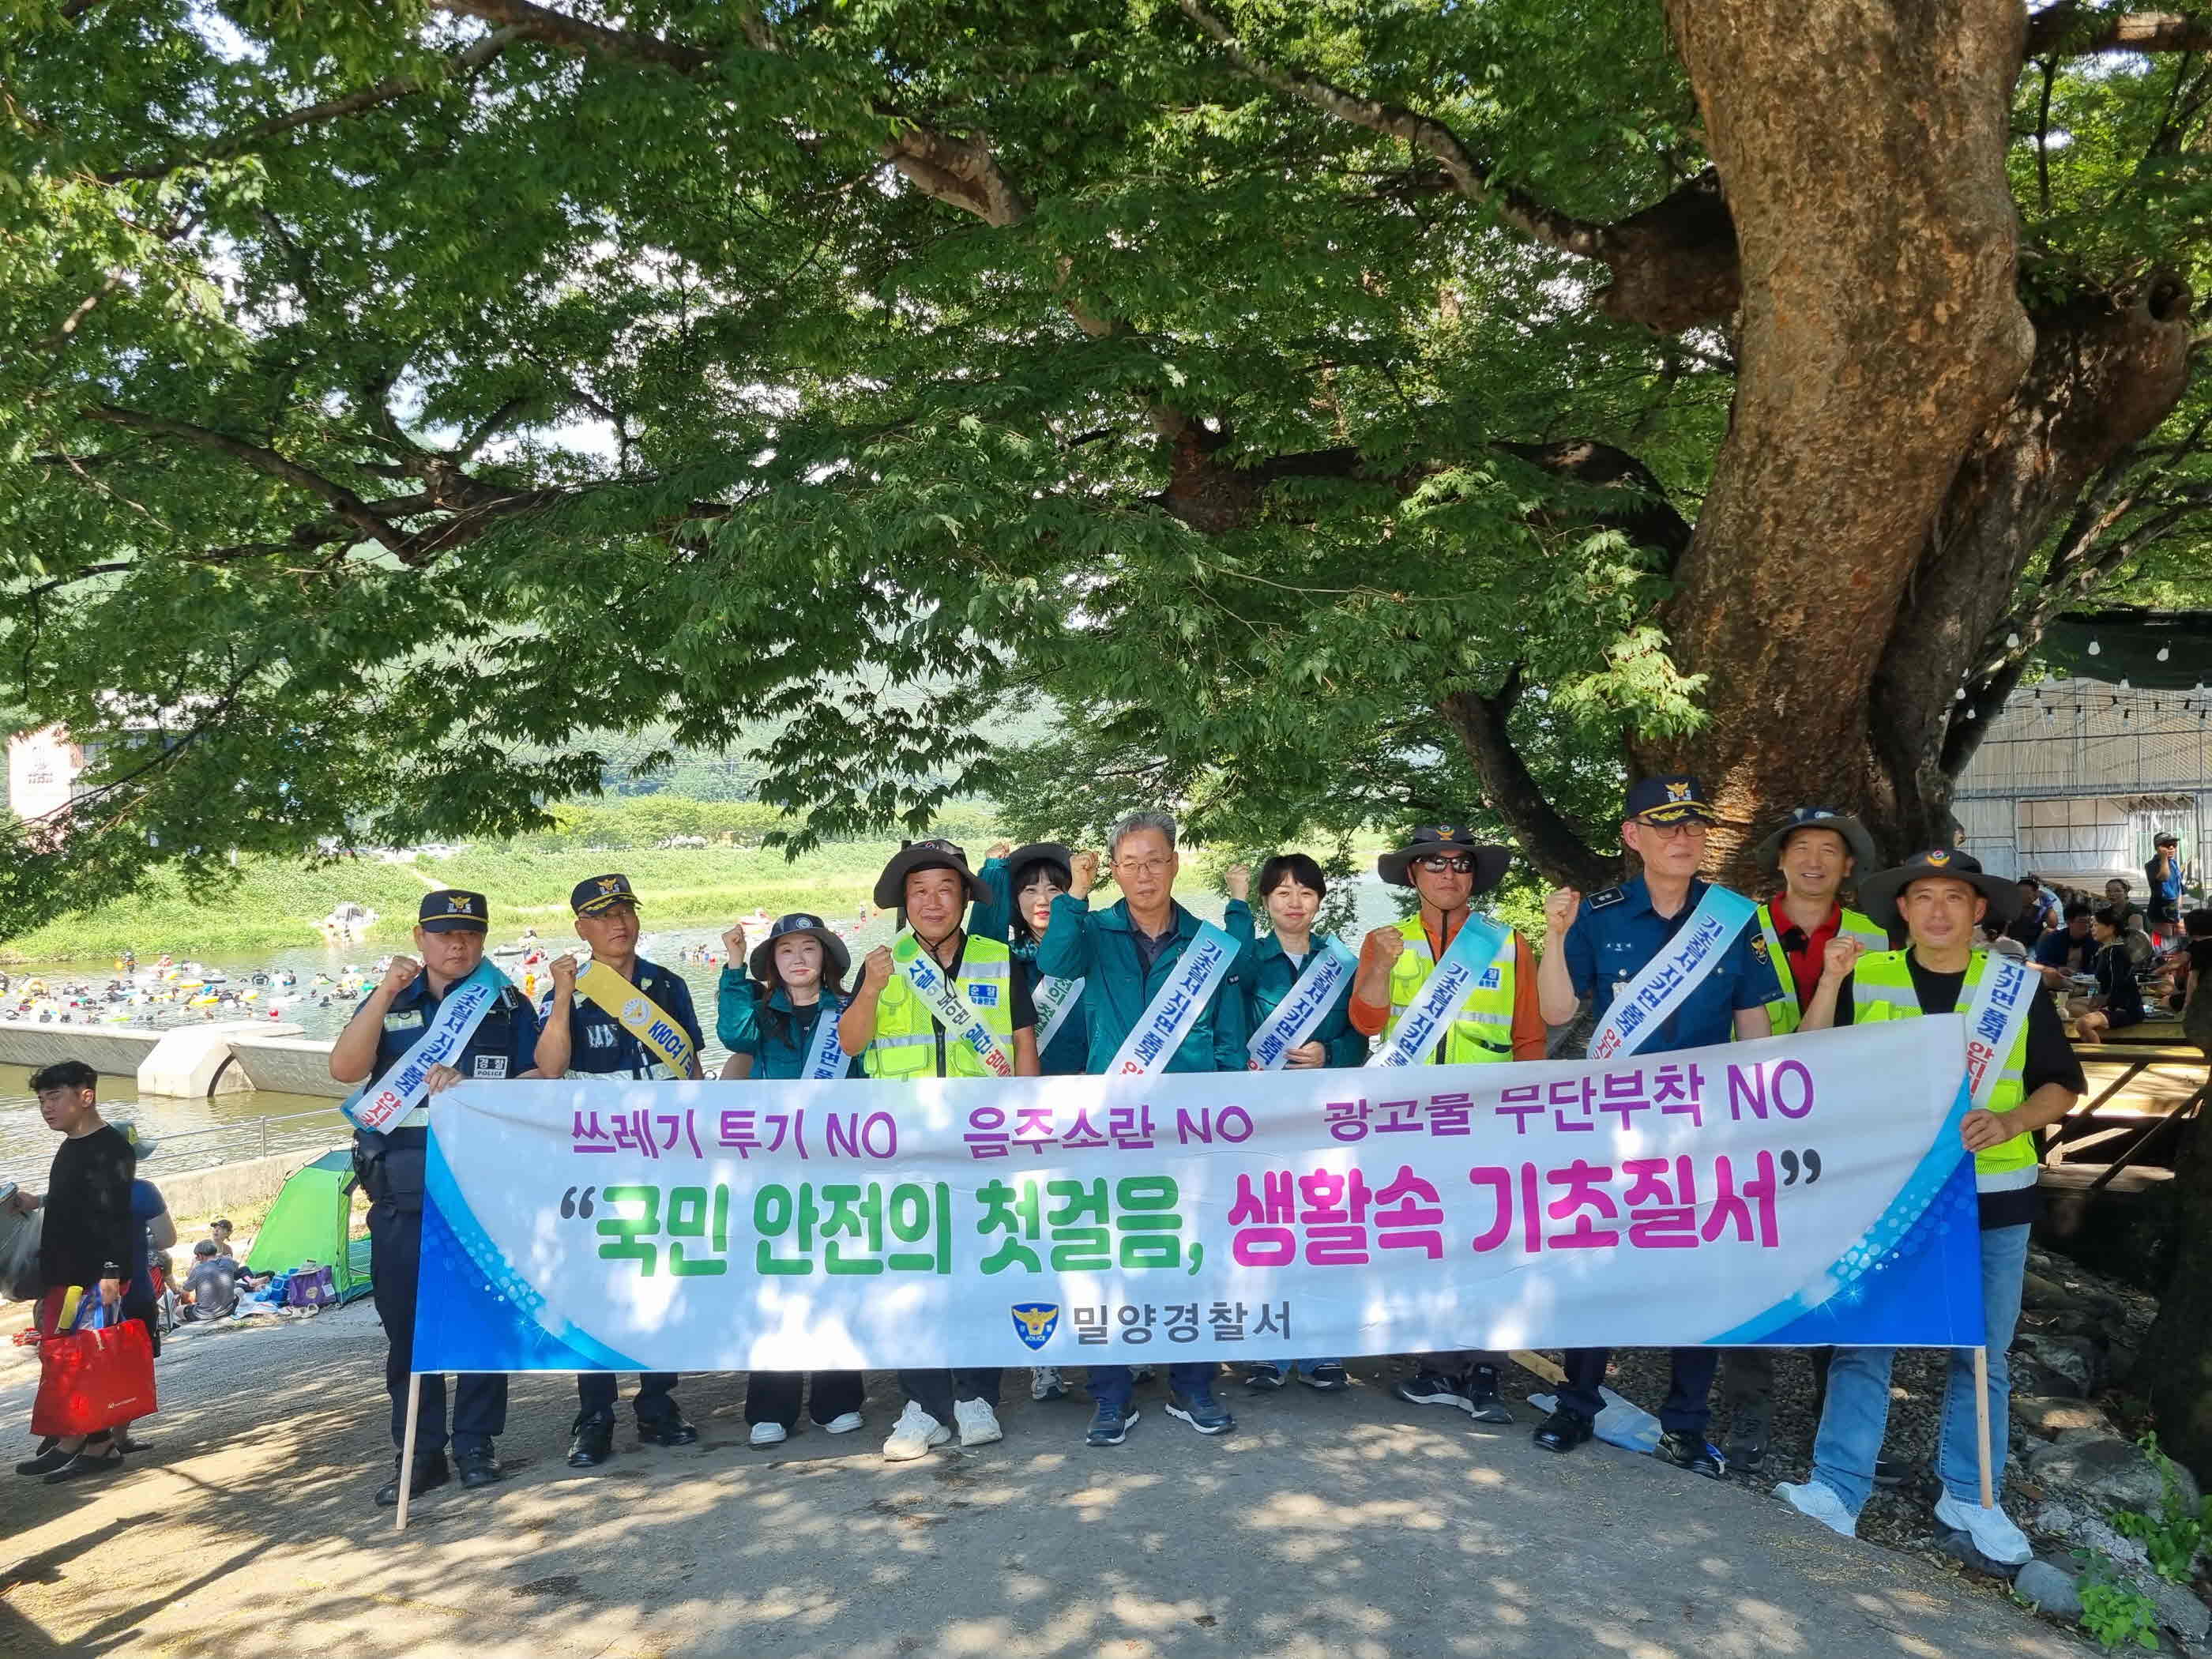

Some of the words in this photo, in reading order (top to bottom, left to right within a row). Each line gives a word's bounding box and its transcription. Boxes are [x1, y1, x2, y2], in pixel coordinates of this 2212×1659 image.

[1180, 939, 1223, 996] 기초질서
[1674, 916, 1724, 973] 기초질서
[1304, 954, 1342, 1005] 기초질서
[1422, 962, 1469, 1019] 기초질서
[1637, 964, 1684, 1012] 지키면
[1991, 963, 2025, 1011] 지키면
[442, 985, 489, 1034] 기초질서
[1153, 989, 1192, 1037] 지키면
[1275, 998, 1315, 1040] 지키면
[1616, 1003, 1646, 1037] 품격
[1977, 1006, 2008, 1044] 품격
[417, 1030, 456, 1066] 지키면
[1134, 1030, 1165, 1067] 품격
[1256, 1033, 1285, 1066] 품격
[1399, 1013, 1435, 1056] 지키면
[394, 1064, 422, 1097] 품격
[572, 1108, 703, 1159] 쓰레기
[718, 1108, 809, 1160] 투기
[826, 1111, 897, 1159] NO
[963, 1104, 1156, 1159] 음주소란
[1176, 1105, 1254, 1145] NO
[1324, 1093, 1474, 1142] 광고물
[1495, 1063, 1706, 1134] 무단부착
[1726, 1059, 1815, 1120] NO
[753, 1181, 952, 1277] 안전의
[976, 1175, 1204, 1276] 첫걸음,
[1228, 1164, 1444, 1266] 생활속
[1074, 1301, 1290, 1345] 밀양경찰서
